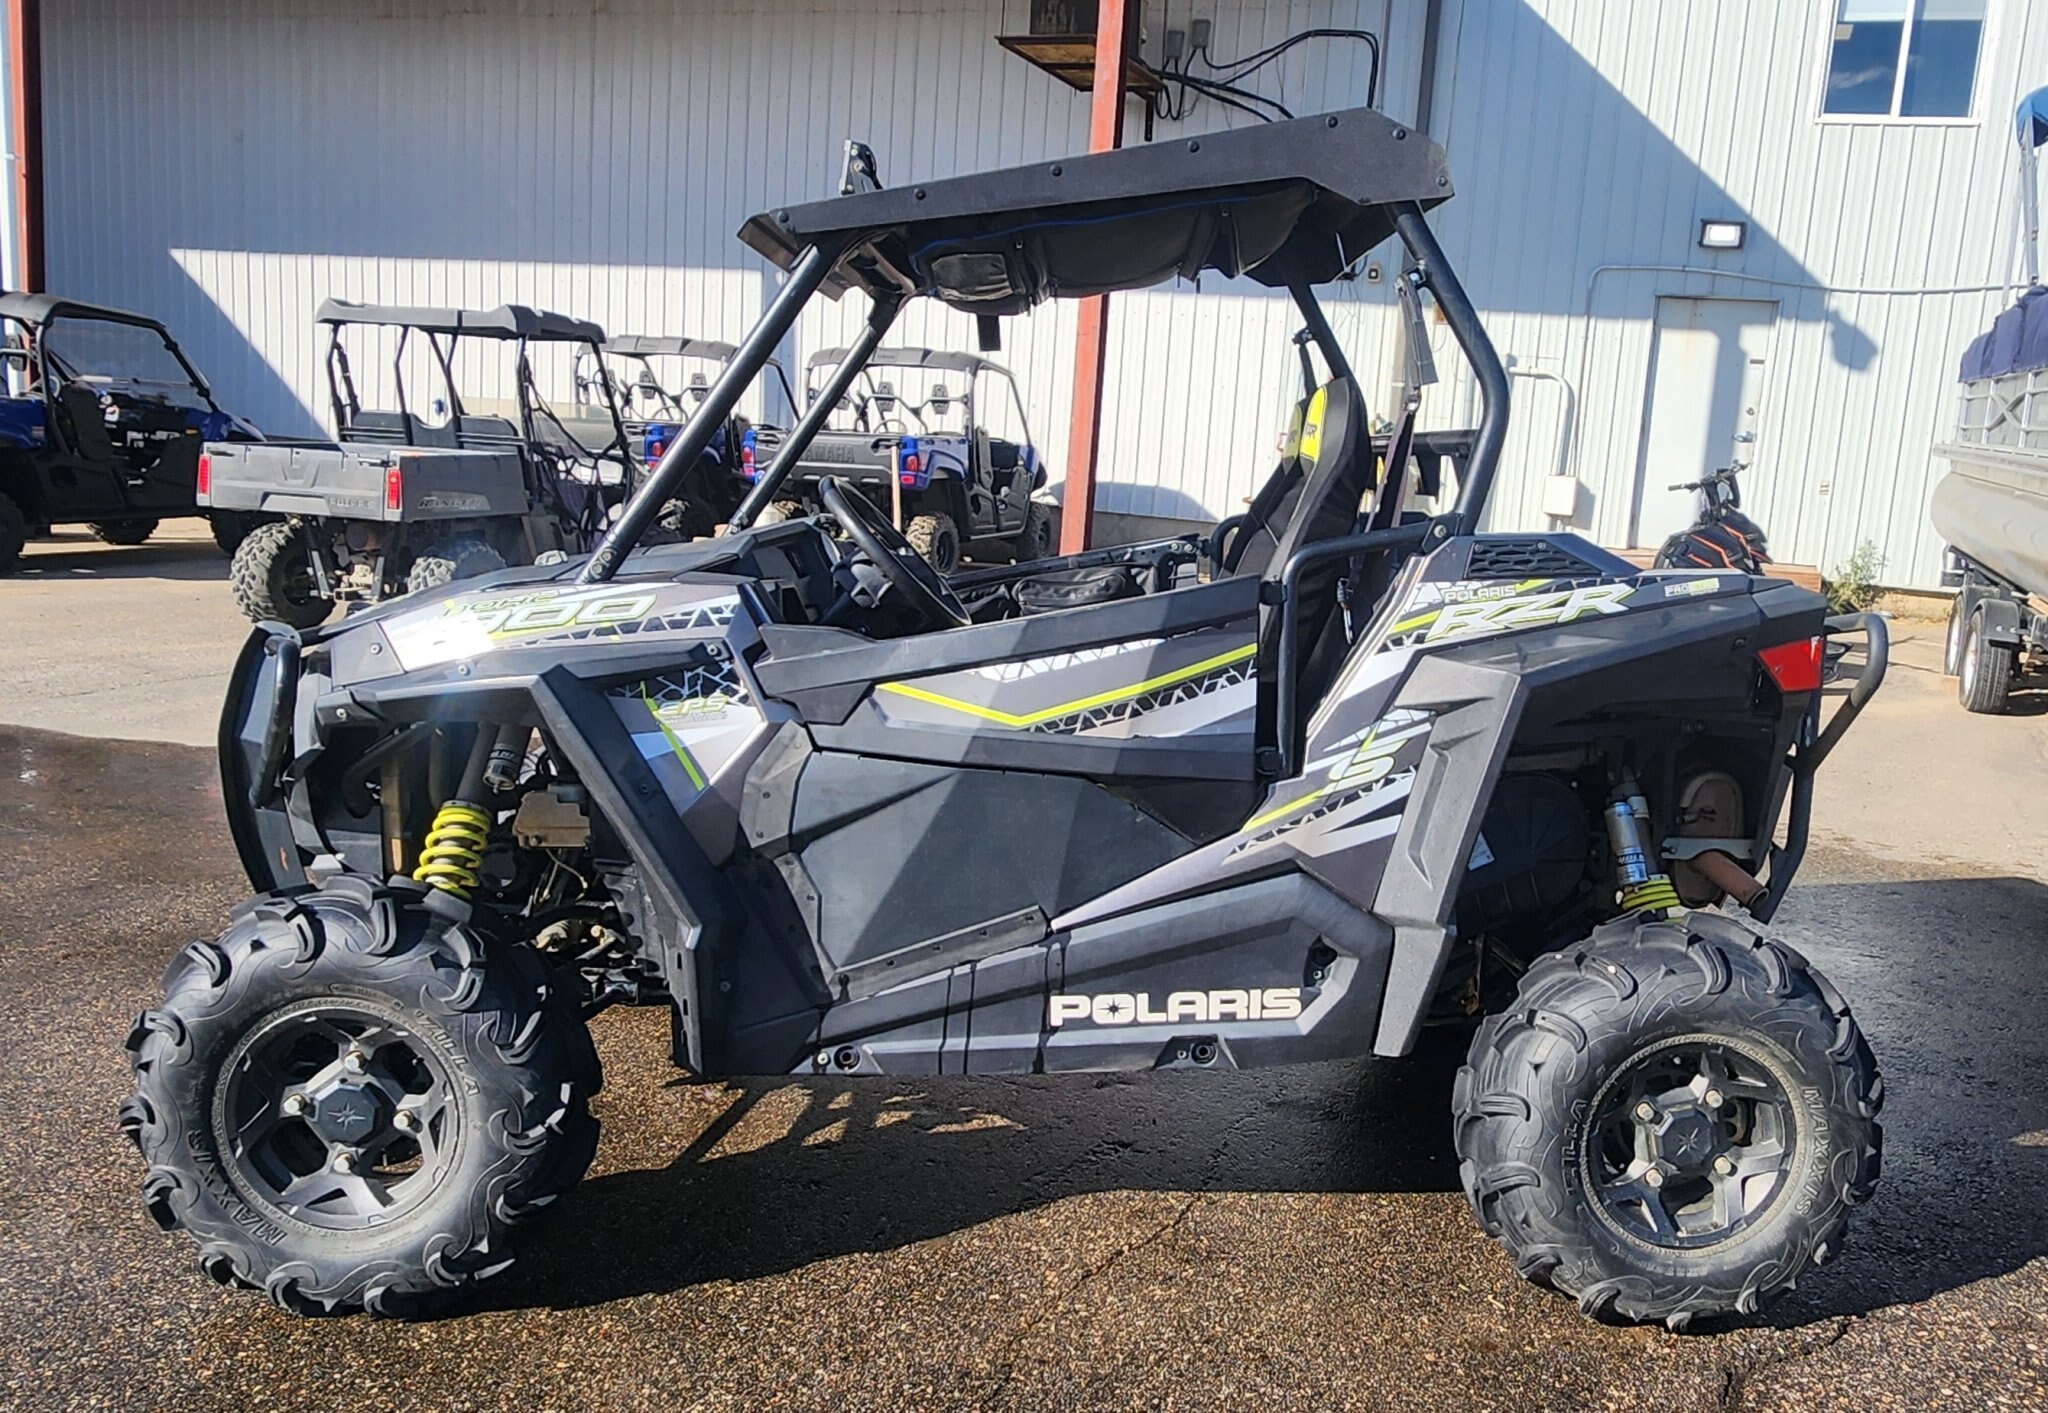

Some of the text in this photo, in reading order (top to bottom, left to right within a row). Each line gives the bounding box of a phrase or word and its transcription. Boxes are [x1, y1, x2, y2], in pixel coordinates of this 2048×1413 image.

[800, 444, 855, 463] AMAHA
[1424, 583, 1635, 643] RZR
[1444, 584, 1517, 602] POLARIS
[656, 692, 730, 717] EPS
[1049, 987, 1302, 1027] POLARIS
[1795, 1086, 1831, 1216] MAXXIS
[187, 1129, 288, 1246] MAXXIS
